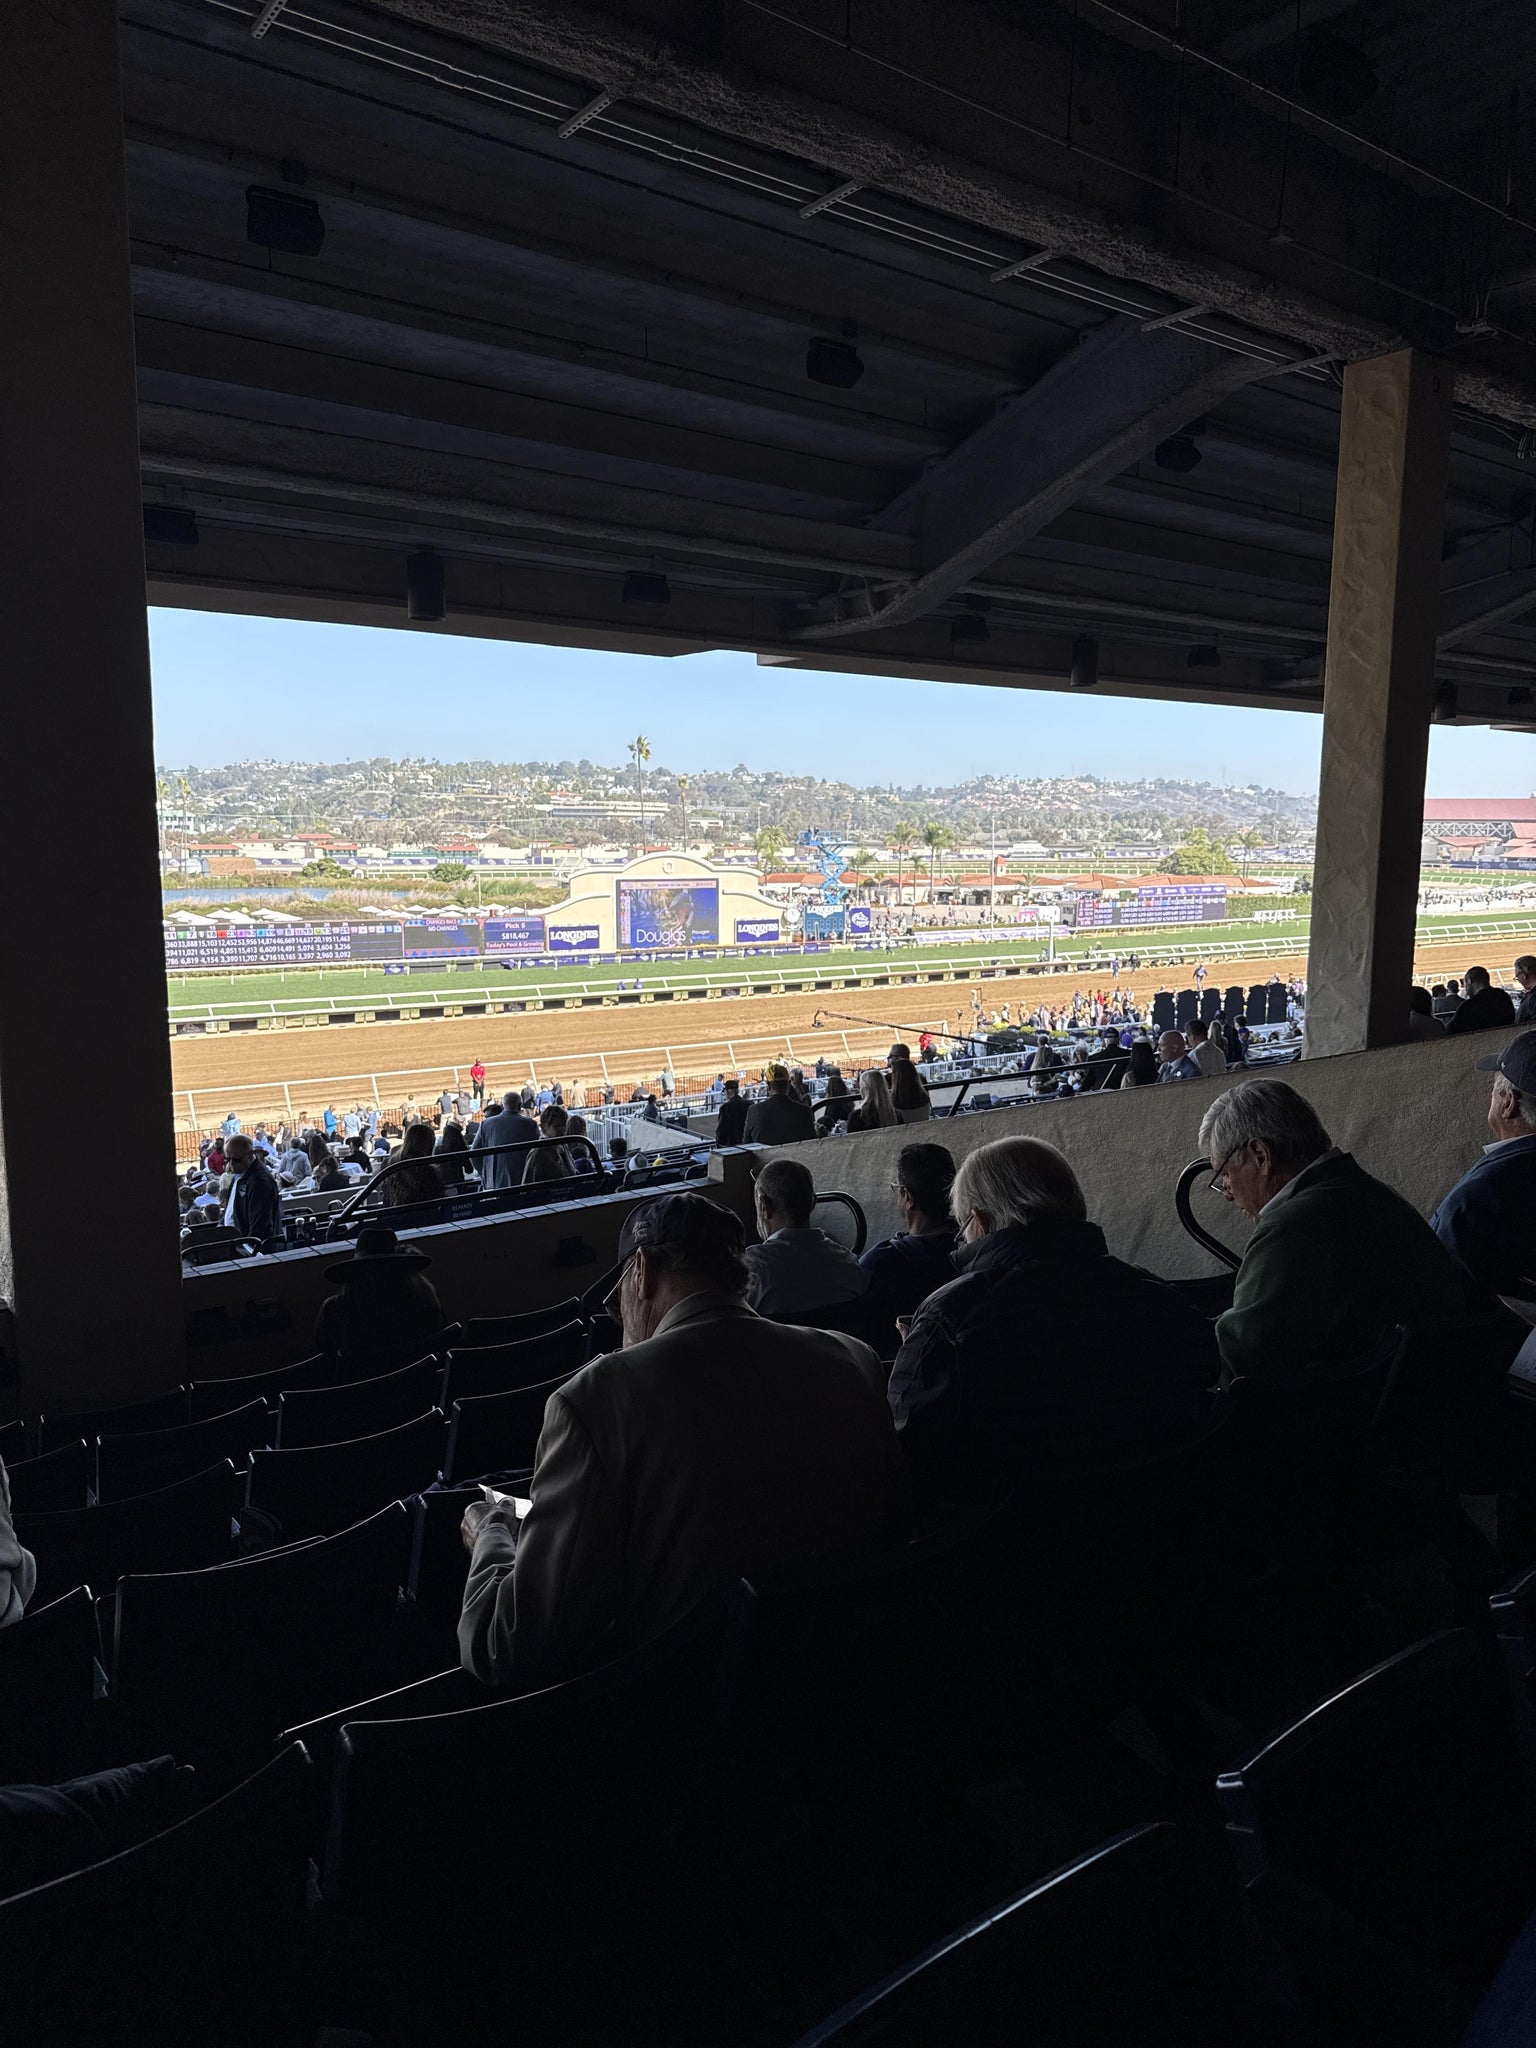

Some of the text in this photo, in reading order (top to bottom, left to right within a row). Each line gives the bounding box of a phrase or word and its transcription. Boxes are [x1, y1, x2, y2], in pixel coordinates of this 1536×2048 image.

[806, 905, 844, 913] LONGINES
[738, 924, 779, 932] LONGINES
[550, 930, 599, 940] LONGINES
[636, 928, 686, 944] Douglas
